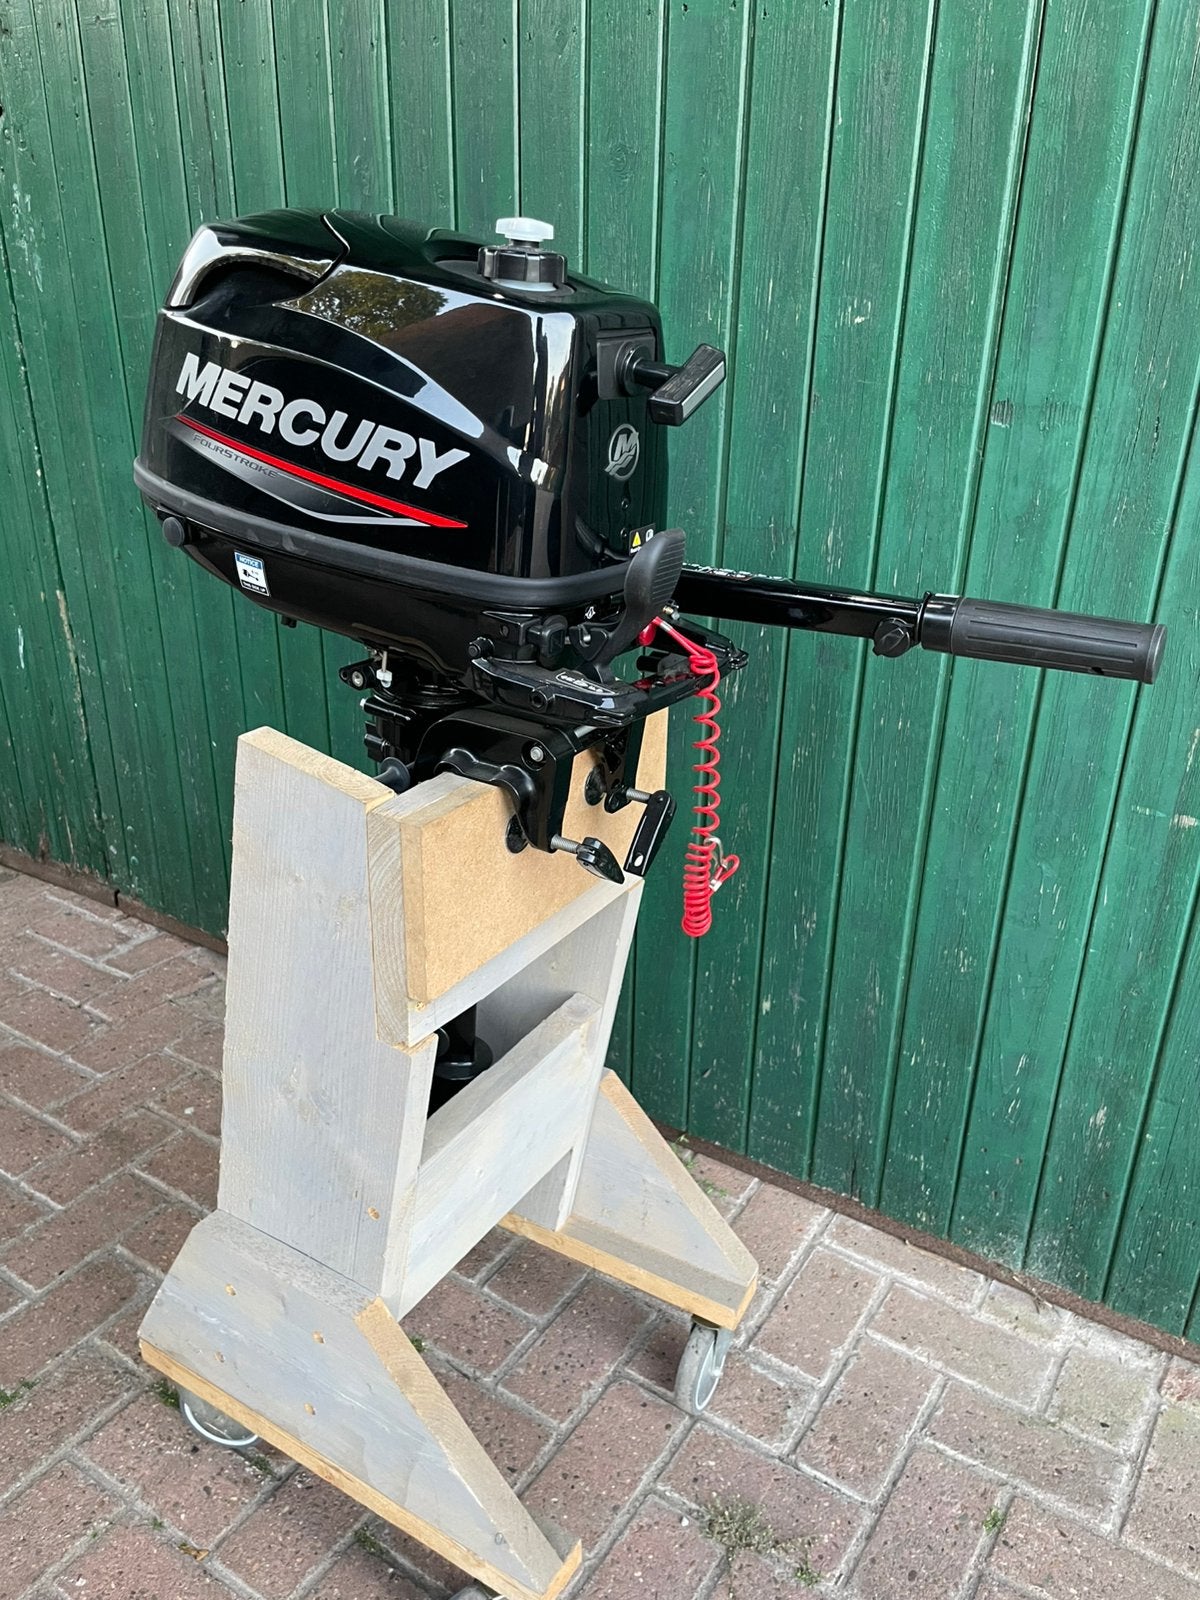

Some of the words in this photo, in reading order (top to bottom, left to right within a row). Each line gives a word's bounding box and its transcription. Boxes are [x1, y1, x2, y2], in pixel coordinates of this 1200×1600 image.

[175, 352, 471, 490] MERCURY
[192, 434, 279, 478] FOURSTROKE
[239, 555, 259, 568] NOTICE
